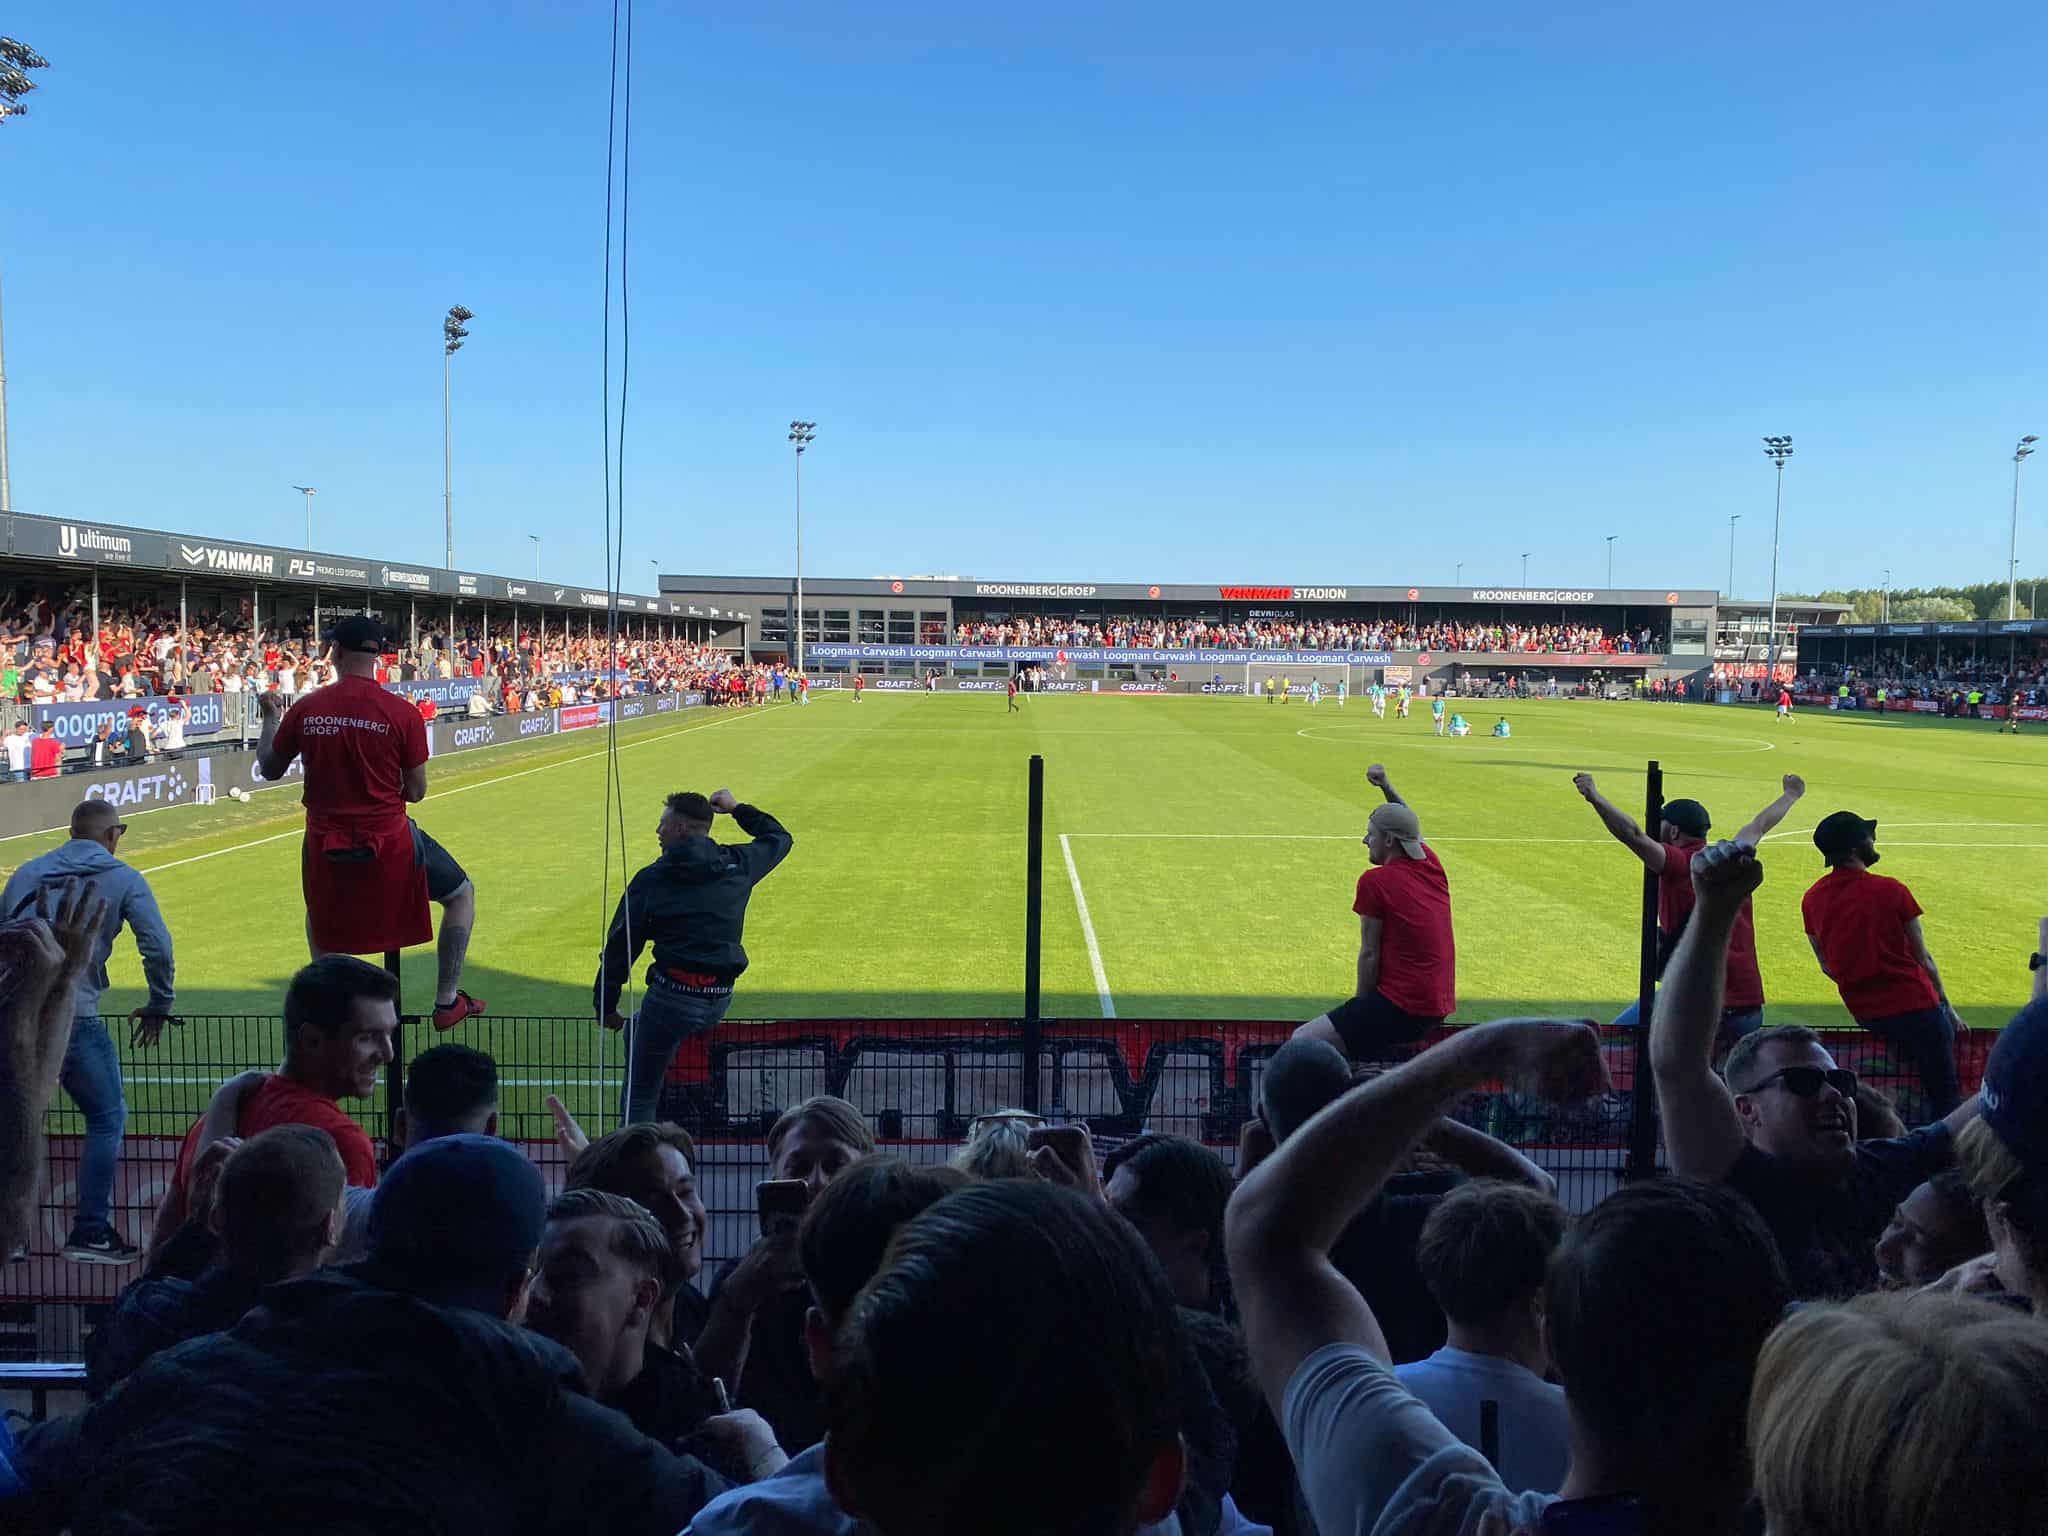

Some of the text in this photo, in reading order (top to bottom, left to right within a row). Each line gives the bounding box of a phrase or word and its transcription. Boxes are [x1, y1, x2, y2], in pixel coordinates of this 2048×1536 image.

[79, 529, 131, 553] ultimum
[206, 548, 274, 574] YANMAR
[288, 559, 315, 576] PLS
[1219, 586, 1347, 600] YANMAR STADION
[812, 645, 1391, 664] Loogman Carwash Loogman Carwash Loogman rwash Loogman Carwash Loogman Carwash Loogman Carwash
[407, 685, 447, 702] ooman
[449, 680, 481, 700] Carwah
[876, 680, 912, 688] CRAFT
[958, 681, 995, 689] CRAFT
[1044, 682, 1076, 691] RAFT
[1120, 683, 1158, 691] CRAFT
[42, 696, 219, 743] Loogma Caash
[519, 717, 545, 735] CRAFT
[303, 726, 339, 736] GROEP
[454, 725, 486, 746] CRAFT
[84, 774, 167, 807] CRAFT
